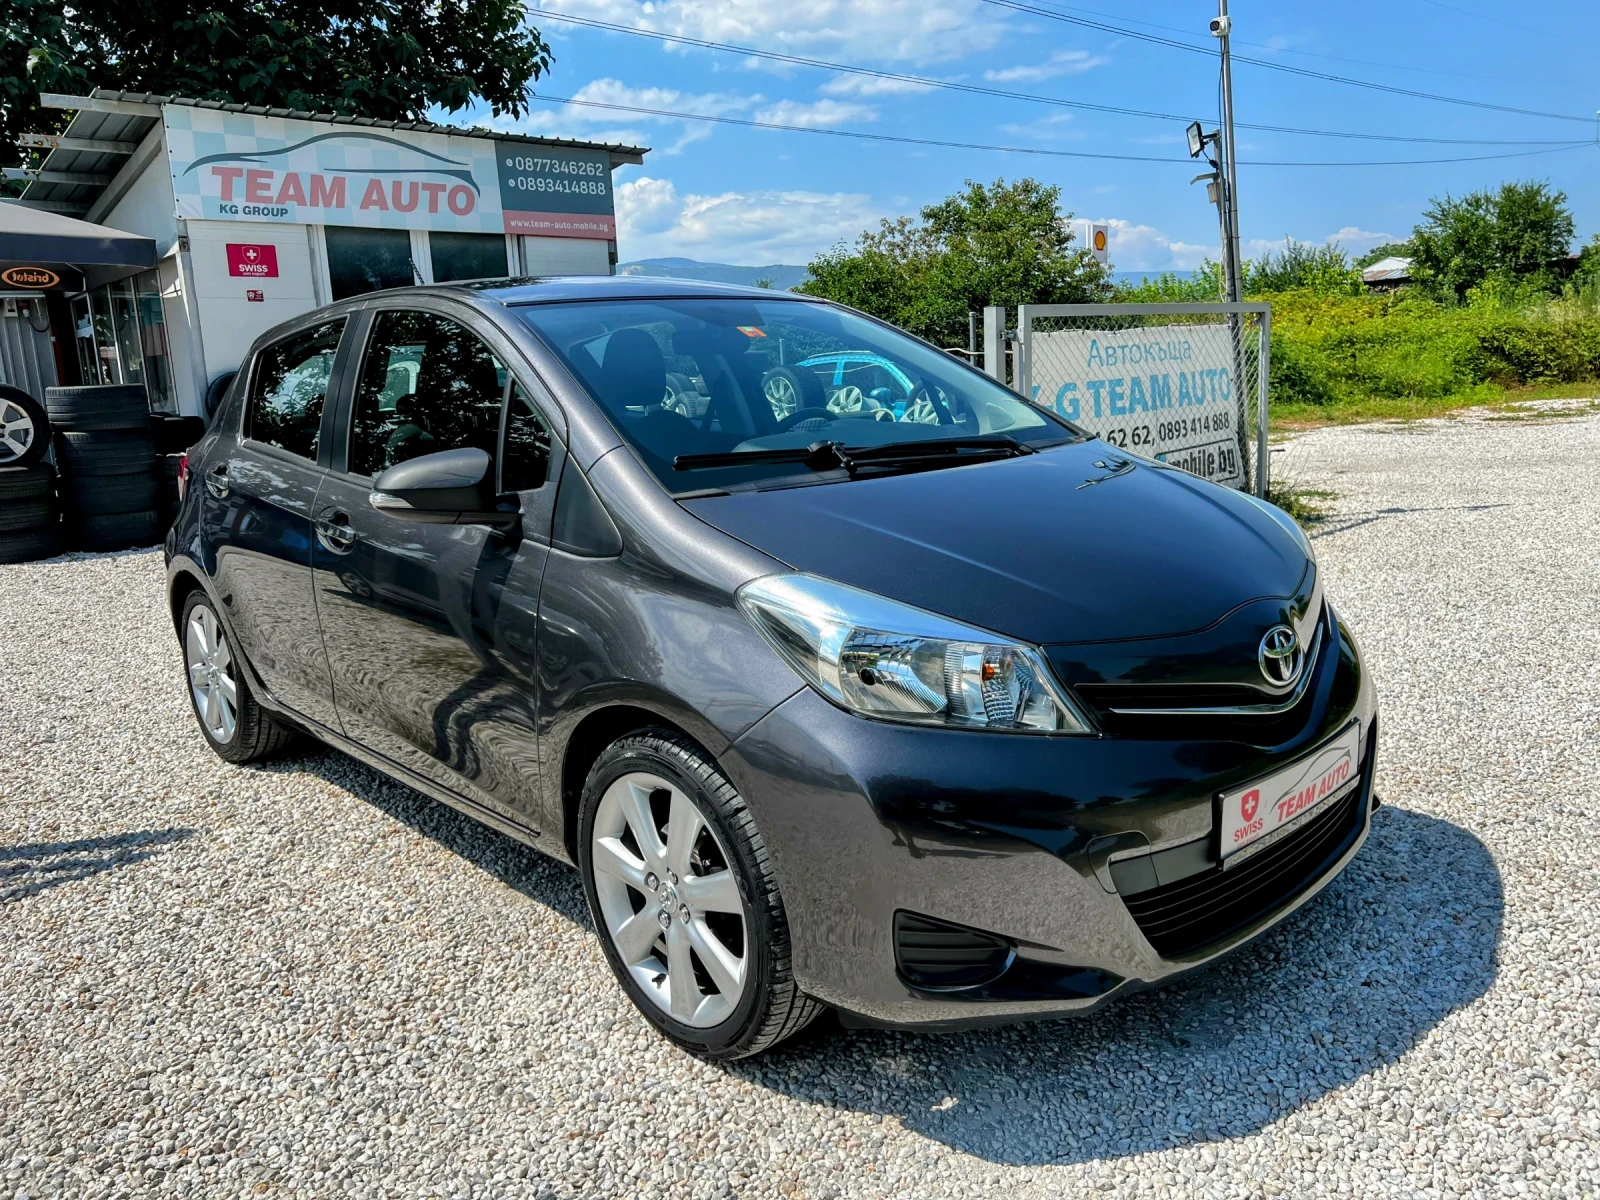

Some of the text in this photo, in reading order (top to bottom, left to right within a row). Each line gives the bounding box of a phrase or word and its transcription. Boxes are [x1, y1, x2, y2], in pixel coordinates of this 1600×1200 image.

[515, 156, 604, 177] 0877346262
[211, 165, 475, 216] TEAM AUTO
[517, 176, 606, 195] 0893414888
[219, 203, 289, 218] KG GROUP
[510, 219, 609, 232] www.team-auto.mobile.bg
[239, 264, 269, 273] SWISS
[1087, 338, 1192, 368] Автокъща
[1086, 373, 1173, 419] TEAM
[1178, 367, 1232, 407] AUTO
[1159, 420, 1188, 442] 0893
[1190, 415, 1211, 436] 414
[1213, 411, 1230, 431] 888
[1277, 760, 1350, 823] TEAM AUTO
[1234, 818, 1263, 842] SWISS
